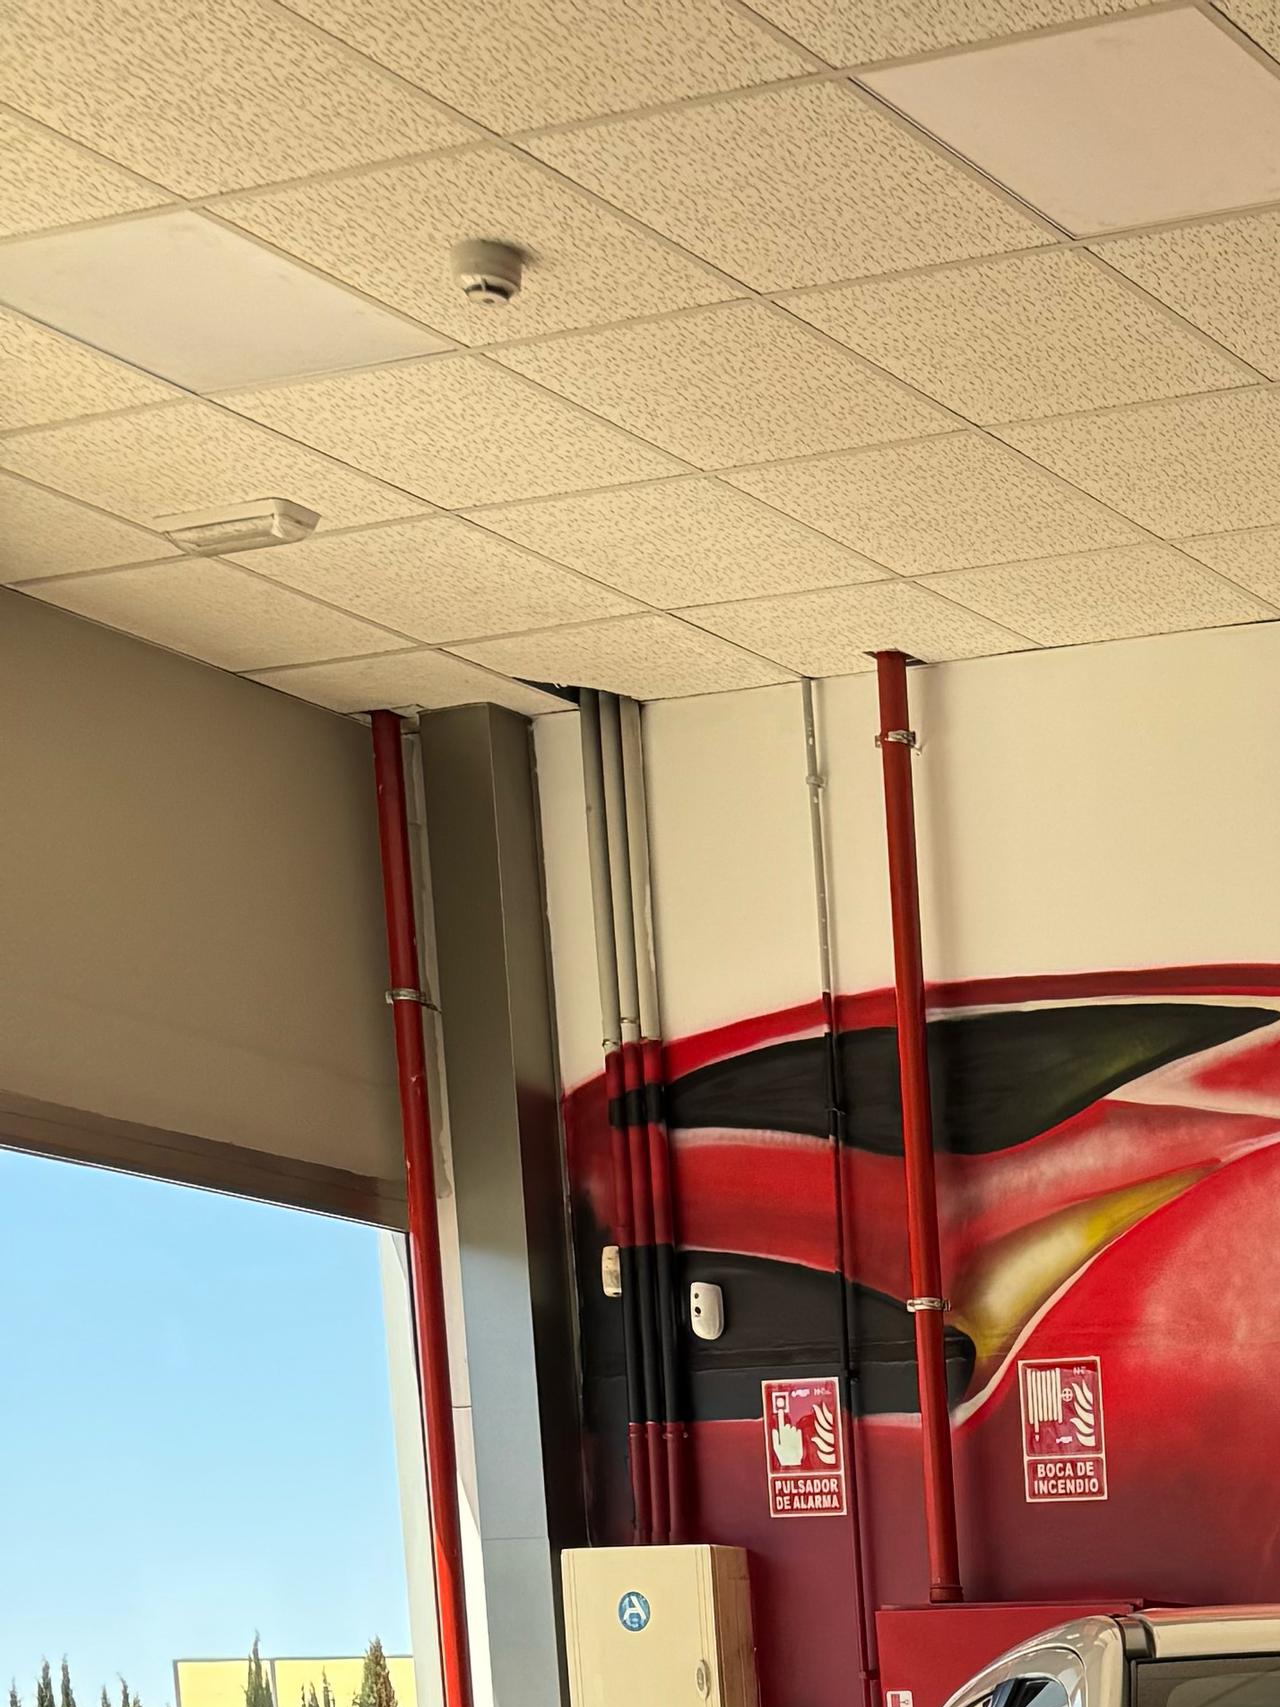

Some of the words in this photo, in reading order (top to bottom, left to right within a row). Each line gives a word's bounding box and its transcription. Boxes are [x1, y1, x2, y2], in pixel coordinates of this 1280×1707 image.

[1037, 1462, 1074, 1478] BOCA
[1076, 1461, 1095, 1476] DE
[775, 1478, 839, 1495] PULSADOR
[1034, 1478, 1099, 1495] INCENDIO
[776, 1496, 792, 1510] DE
[793, 1494, 840, 1510] ALARMA
